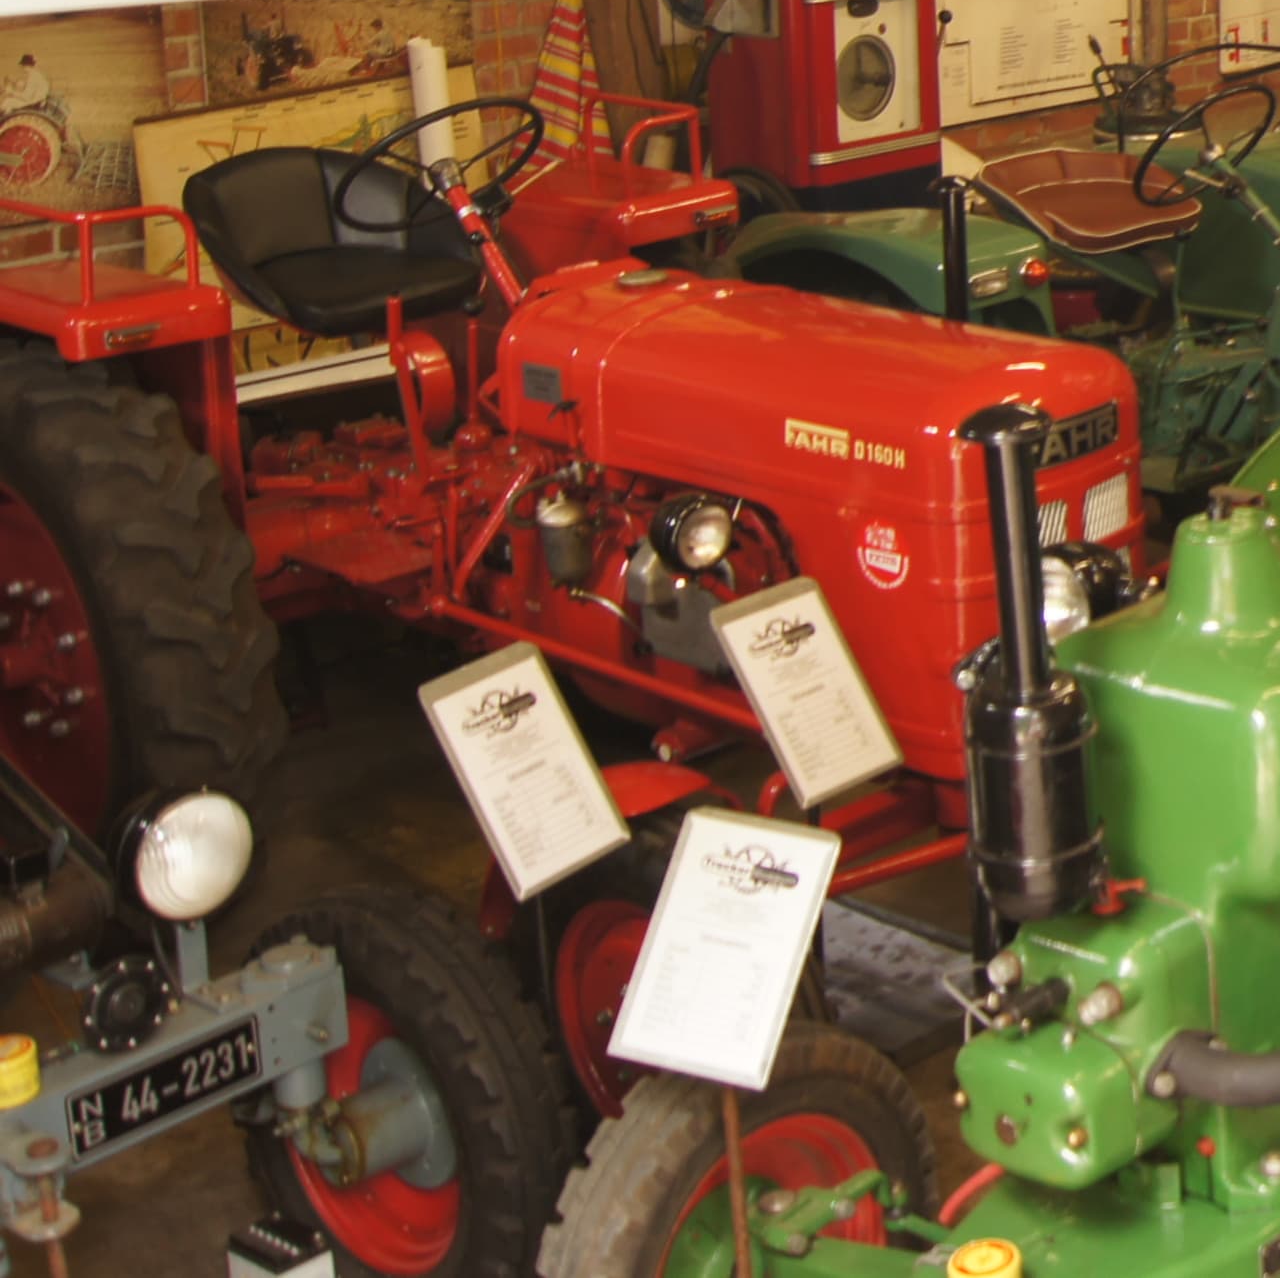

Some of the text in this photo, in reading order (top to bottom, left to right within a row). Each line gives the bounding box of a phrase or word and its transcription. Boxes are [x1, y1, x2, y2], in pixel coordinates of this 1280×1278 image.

[784, 417, 849, 460] FAHR
[1039, 402, 1117, 467] AHR
[121, 1034, 250, 1122] 44-2231
